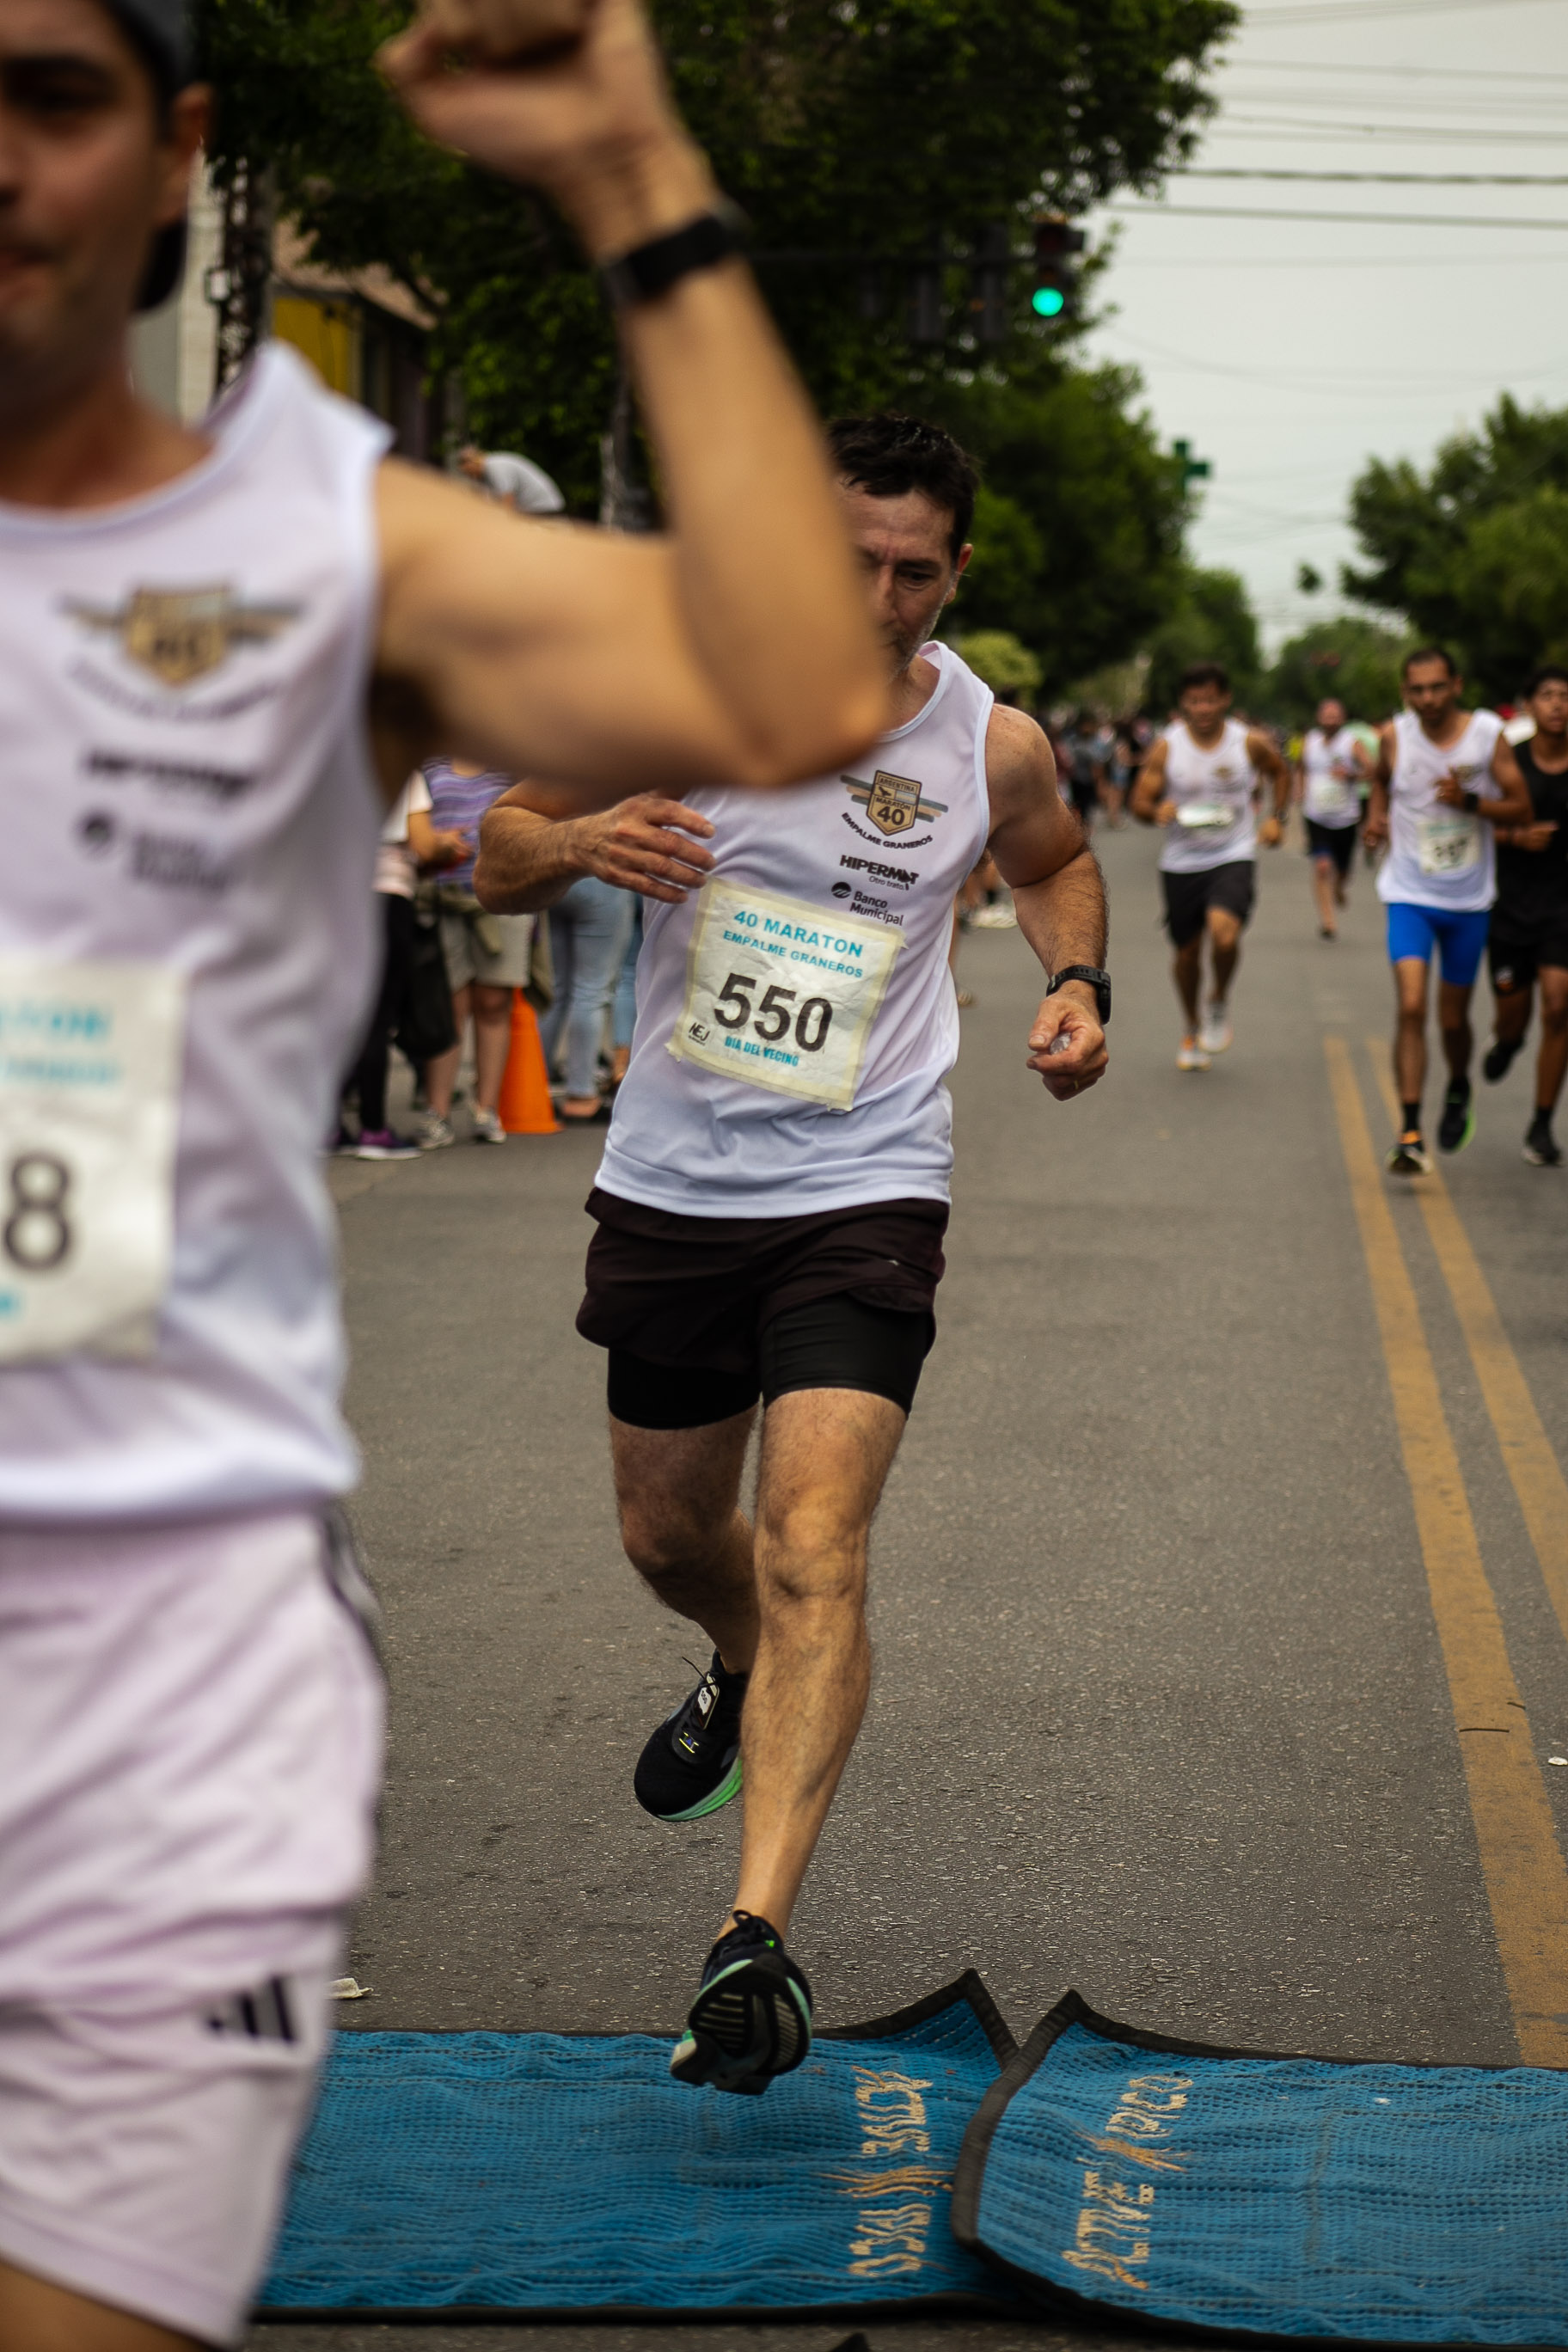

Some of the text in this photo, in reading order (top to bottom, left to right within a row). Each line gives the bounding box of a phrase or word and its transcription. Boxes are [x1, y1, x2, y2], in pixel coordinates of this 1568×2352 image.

[879, 777, 916, 793] ARGENTINA
[875, 797, 911, 811] MARATÓN
[877, 806, 905, 826] 40
[842, 812, 933, 849] EMPALME GRANEROS
[869, 875, 885, 885] Otro
[854, 891, 888, 908] Banco
[850, 903, 903, 926] Municipal
[734, 911, 863, 958] 40 MARATON
[723, 930, 863, 977] EMPALME GRANEROS
[714, 972, 832, 1052] 550
[744, 1042, 760, 1057] DEL
[763, 1047, 799, 1067] VECINO
[1061, 2171, 1155, 2290] ACTIVE
